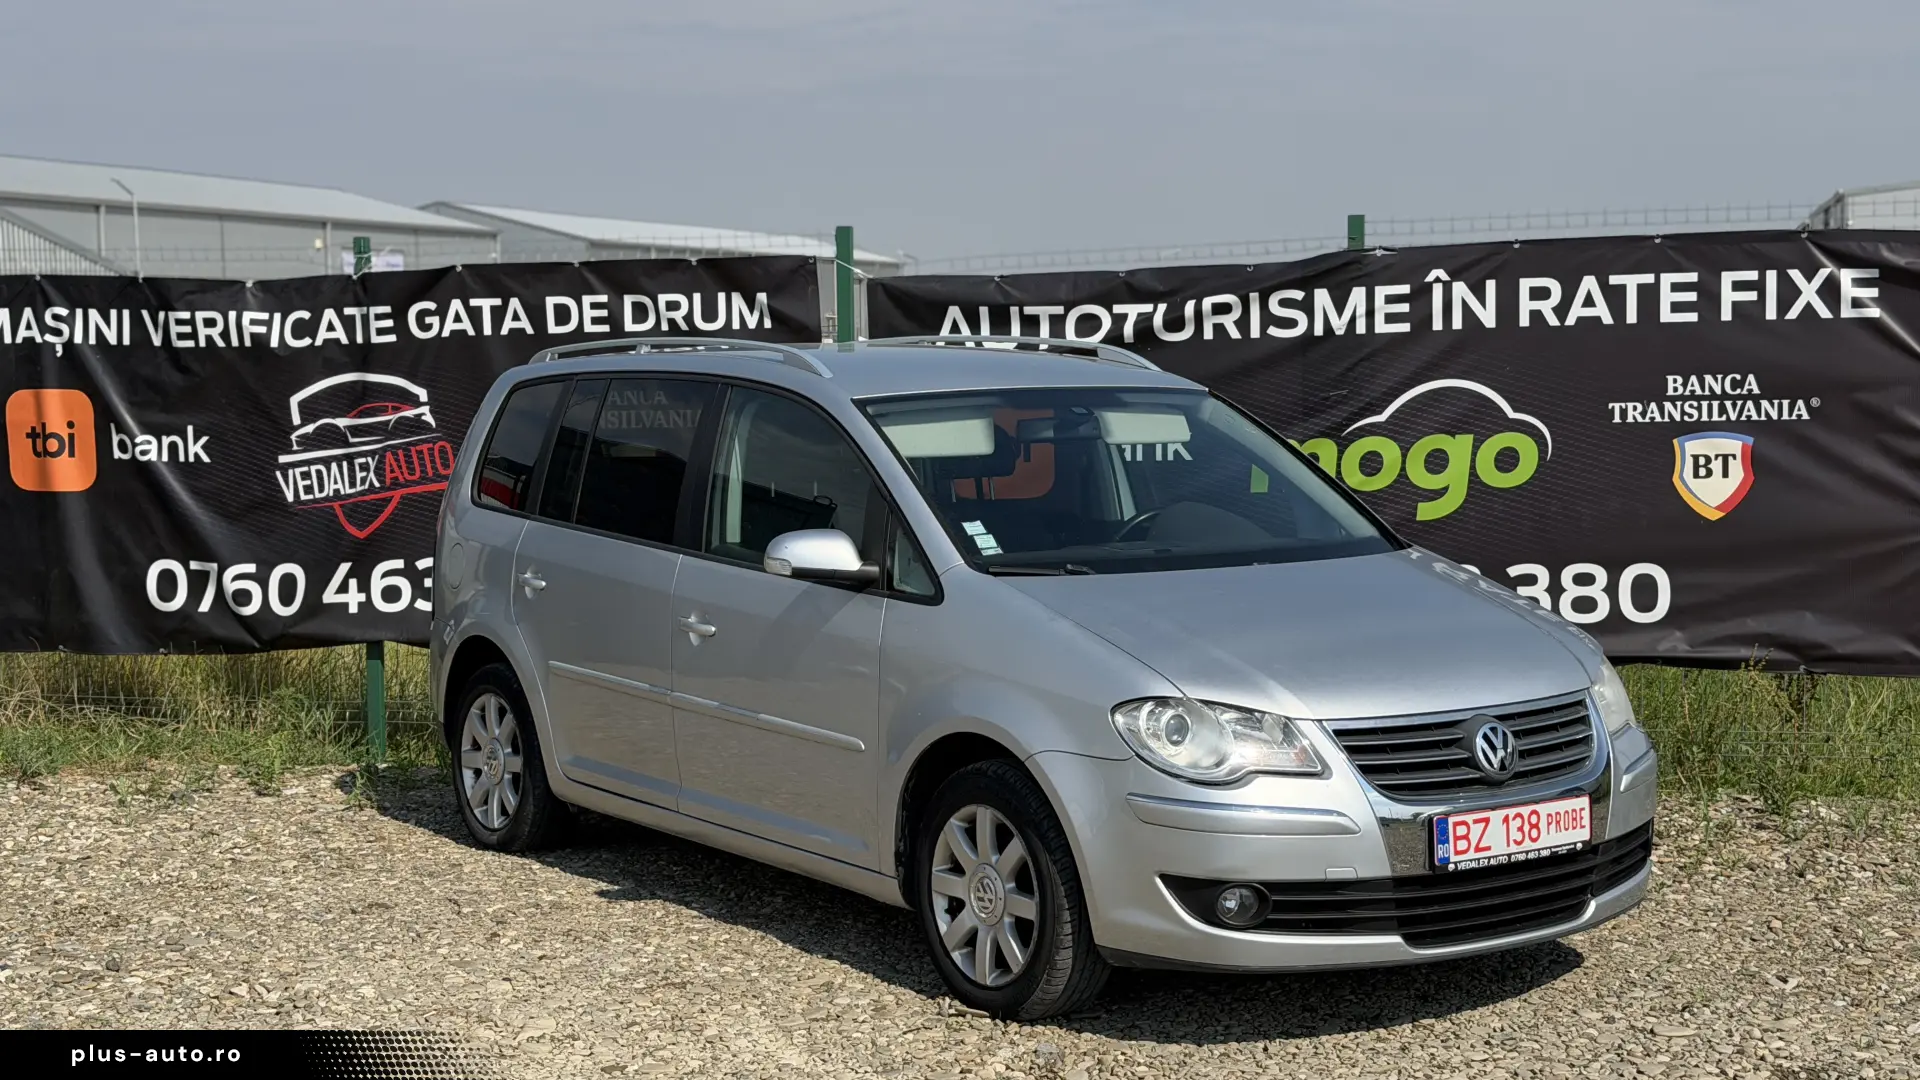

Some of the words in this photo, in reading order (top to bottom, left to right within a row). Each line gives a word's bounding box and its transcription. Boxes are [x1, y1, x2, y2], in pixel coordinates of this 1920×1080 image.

[141, 306, 397, 348] VERIFICATE
[408, 298, 534, 339] GATA
[546, 295, 610, 333] DE
[624, 292, 772, 332] DRUM
[935, 286, 1411, 351] AUTOTURISME
[1424, 269, 1497, 331] ÎN
[1519, 272, 1698, 327] RATE
[1721, 268, 1881, 321] FIXE
[1666, 374, 1761, 396] BANCA
[25, 421, 76, 459] tbi
[111, 425, 211, 463] bank
[1690, 453, 1737, 480] BT
[276, 454, 381, 502] VEDALEX
[385, 441, 455, 486] AUTO
[146, 559, 306, 616] 0760
[1505, 562, 1671, 624] 380
[1438, 843, 1449, 858] RO
[1452, 816, 1492, 857] BZ
[1501, 809, 1541, 848] 138
[1546, 807, 1586, 836] PROBE
[1457, 858, 1489, 870] VEDALEX
[1489, 855, 1508, 866] AUTO
